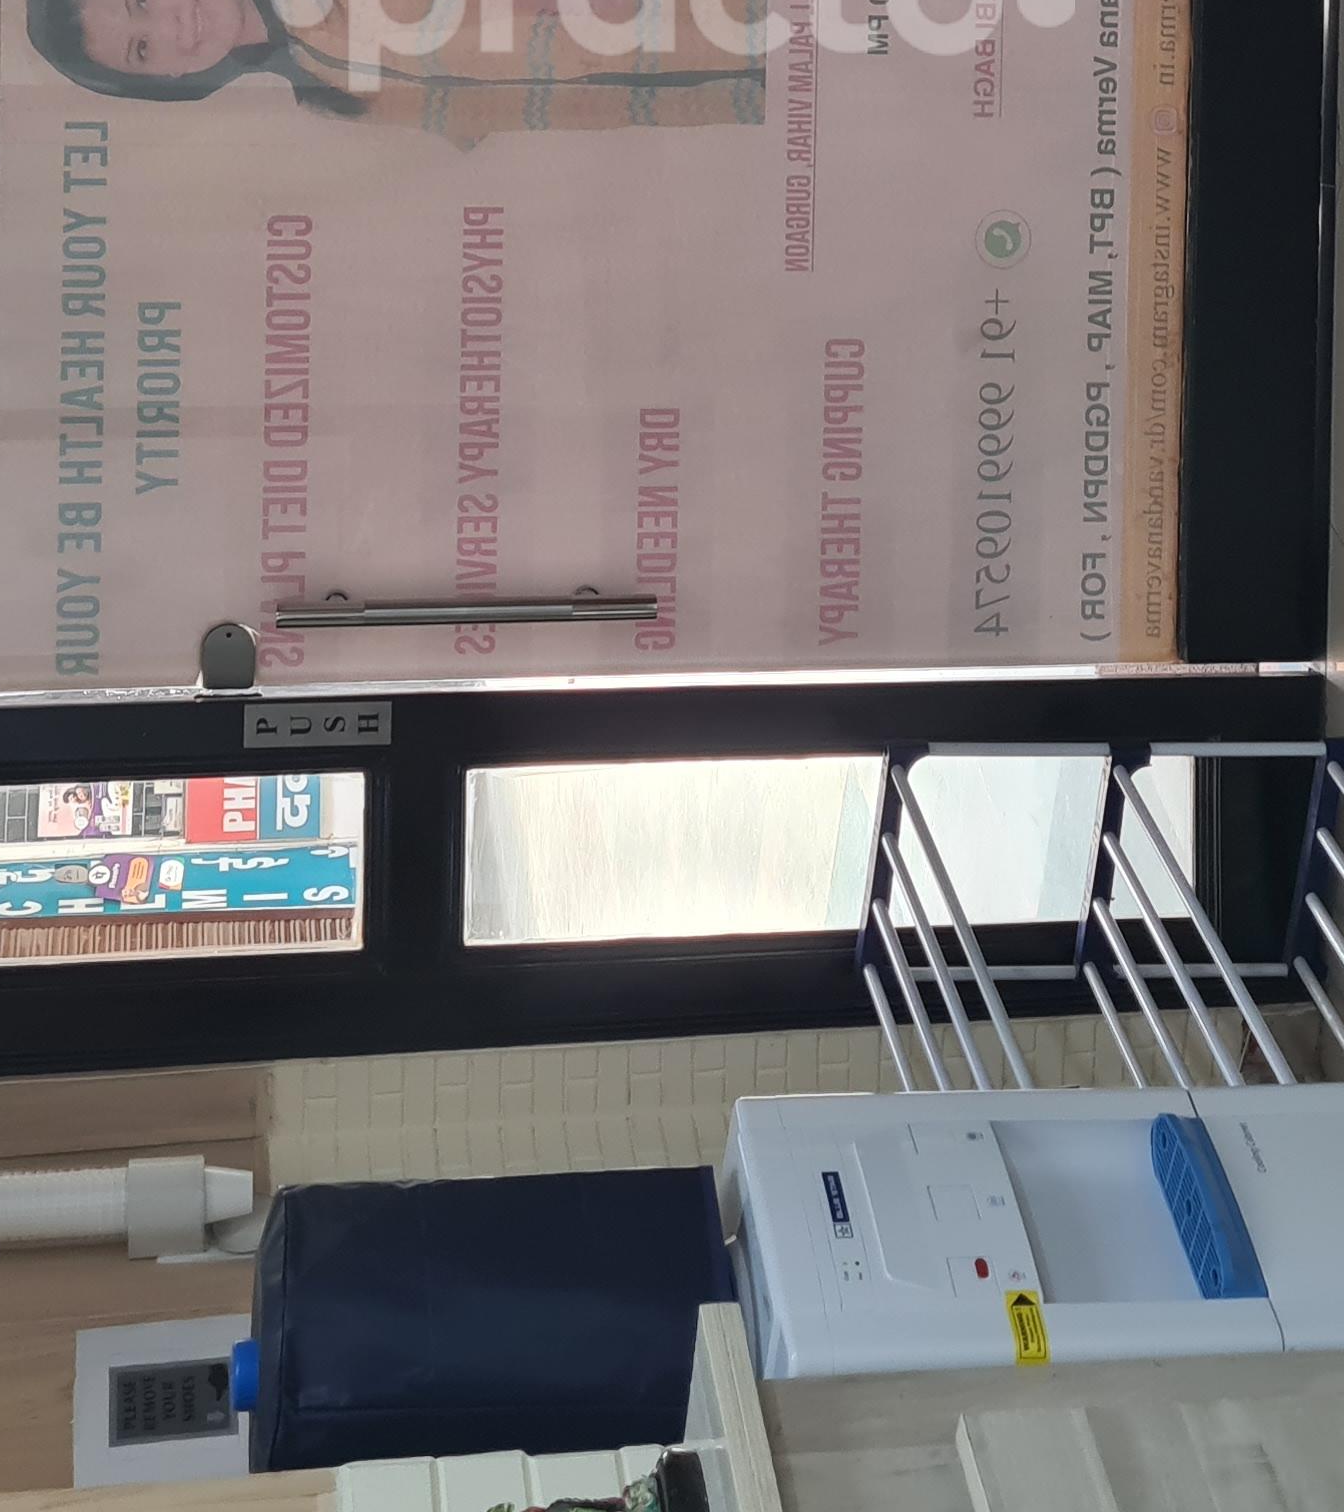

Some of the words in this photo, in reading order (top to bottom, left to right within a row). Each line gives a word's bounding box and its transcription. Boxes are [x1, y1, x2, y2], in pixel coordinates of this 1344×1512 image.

[256, 712, 380, 736] PUSH
[123, 1381, 137, 1430] PLEASE
[142, 1376, 156, 1430] REMOVE
[162, 1381, 177, 1420] YOUR
[181, 1376, 195, 1422] SHOES
